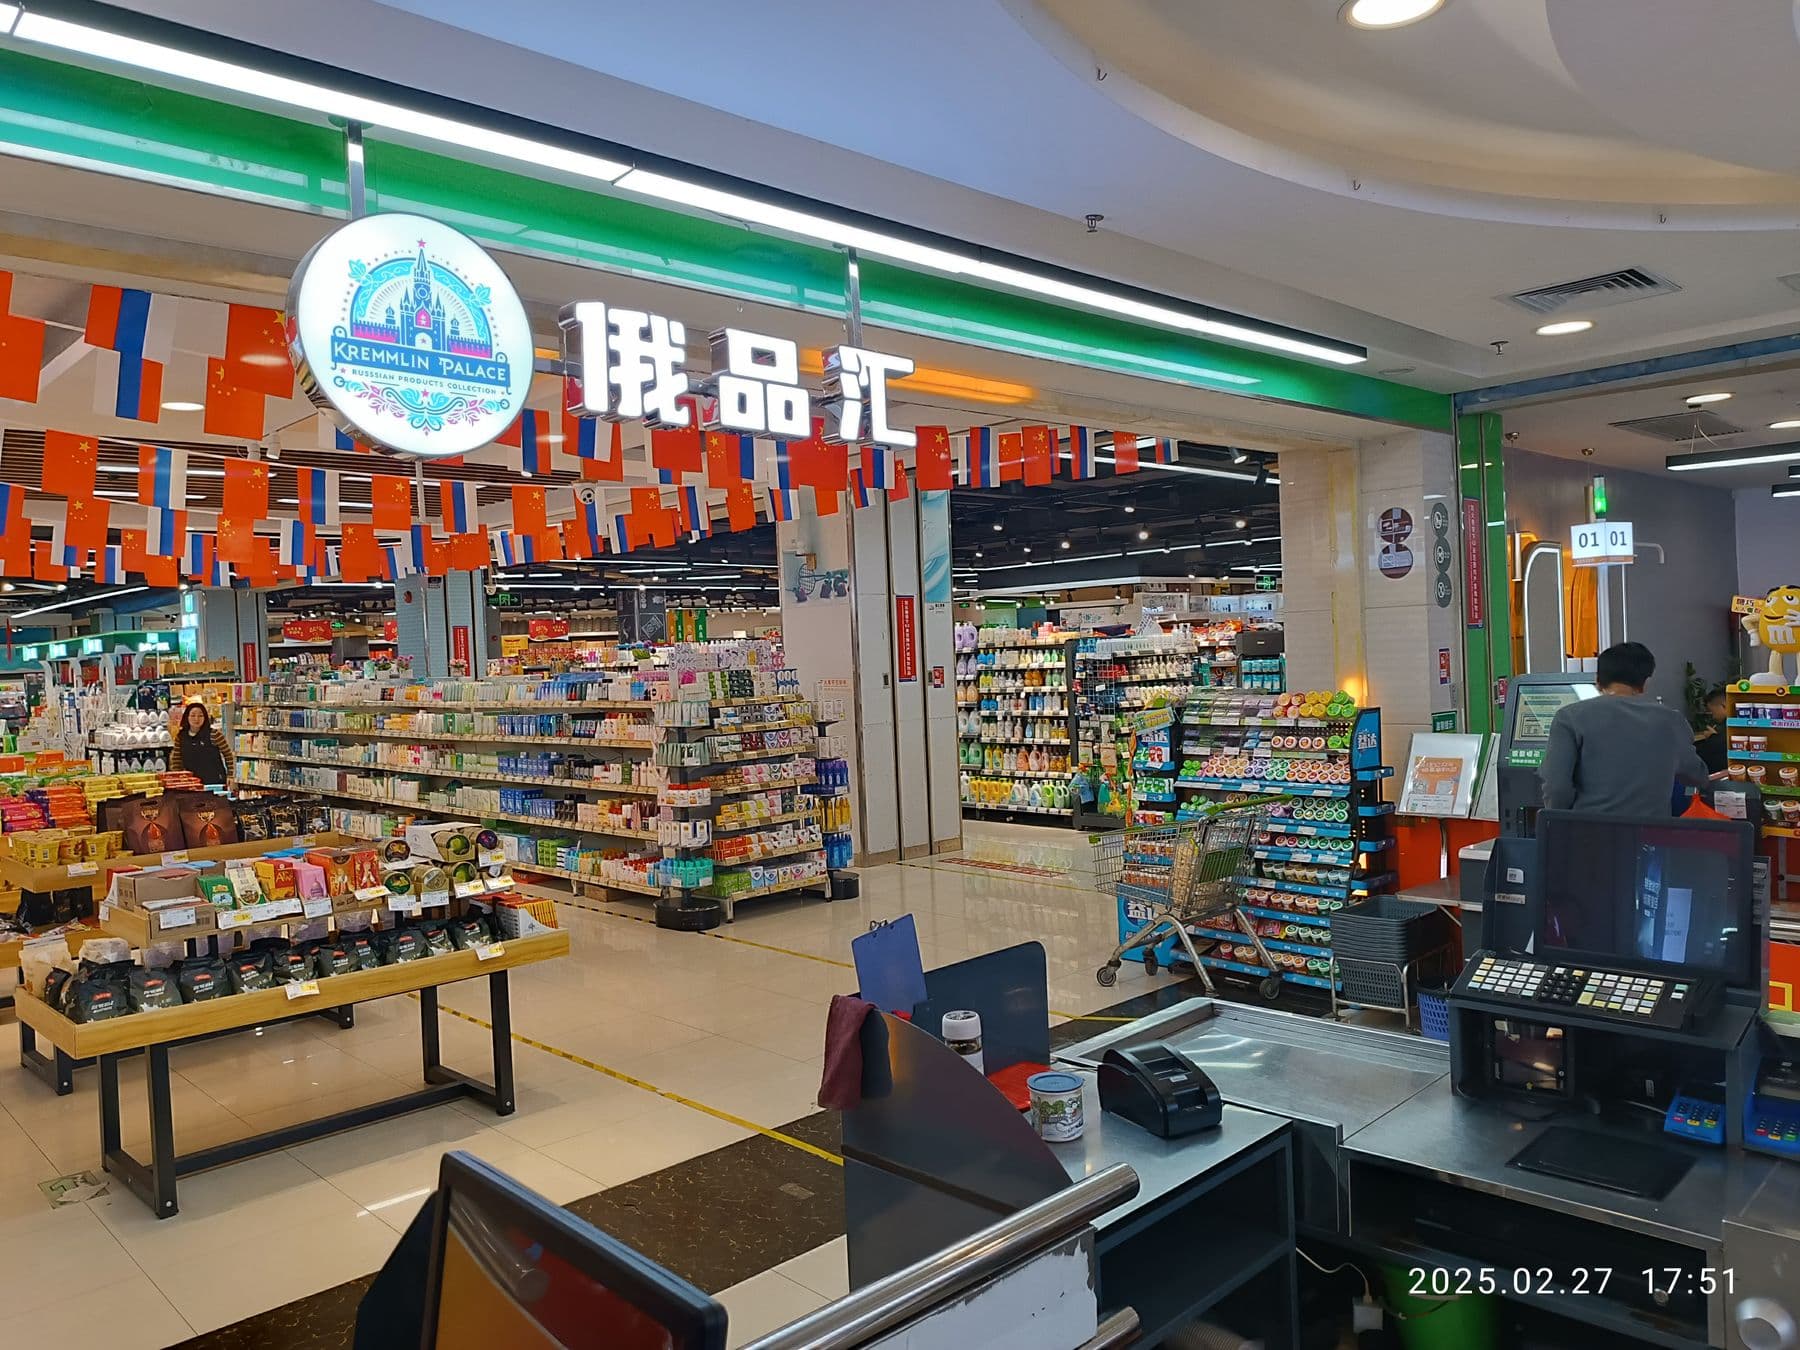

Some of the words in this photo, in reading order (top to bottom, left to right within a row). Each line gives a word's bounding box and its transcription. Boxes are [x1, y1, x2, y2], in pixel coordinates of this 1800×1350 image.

[334, 342, 430, 371] KREMMLIN
[438, 356, 507, 381] PALACE
[575, 301, 918, 447] 俄品汇
[398, 375, 444, 388] PRODUCTS
[447, 382, 497, 395] COLLECTION
[1578, 531, 1600, 549] 01
[1609, 530, 1627, 546] 01
